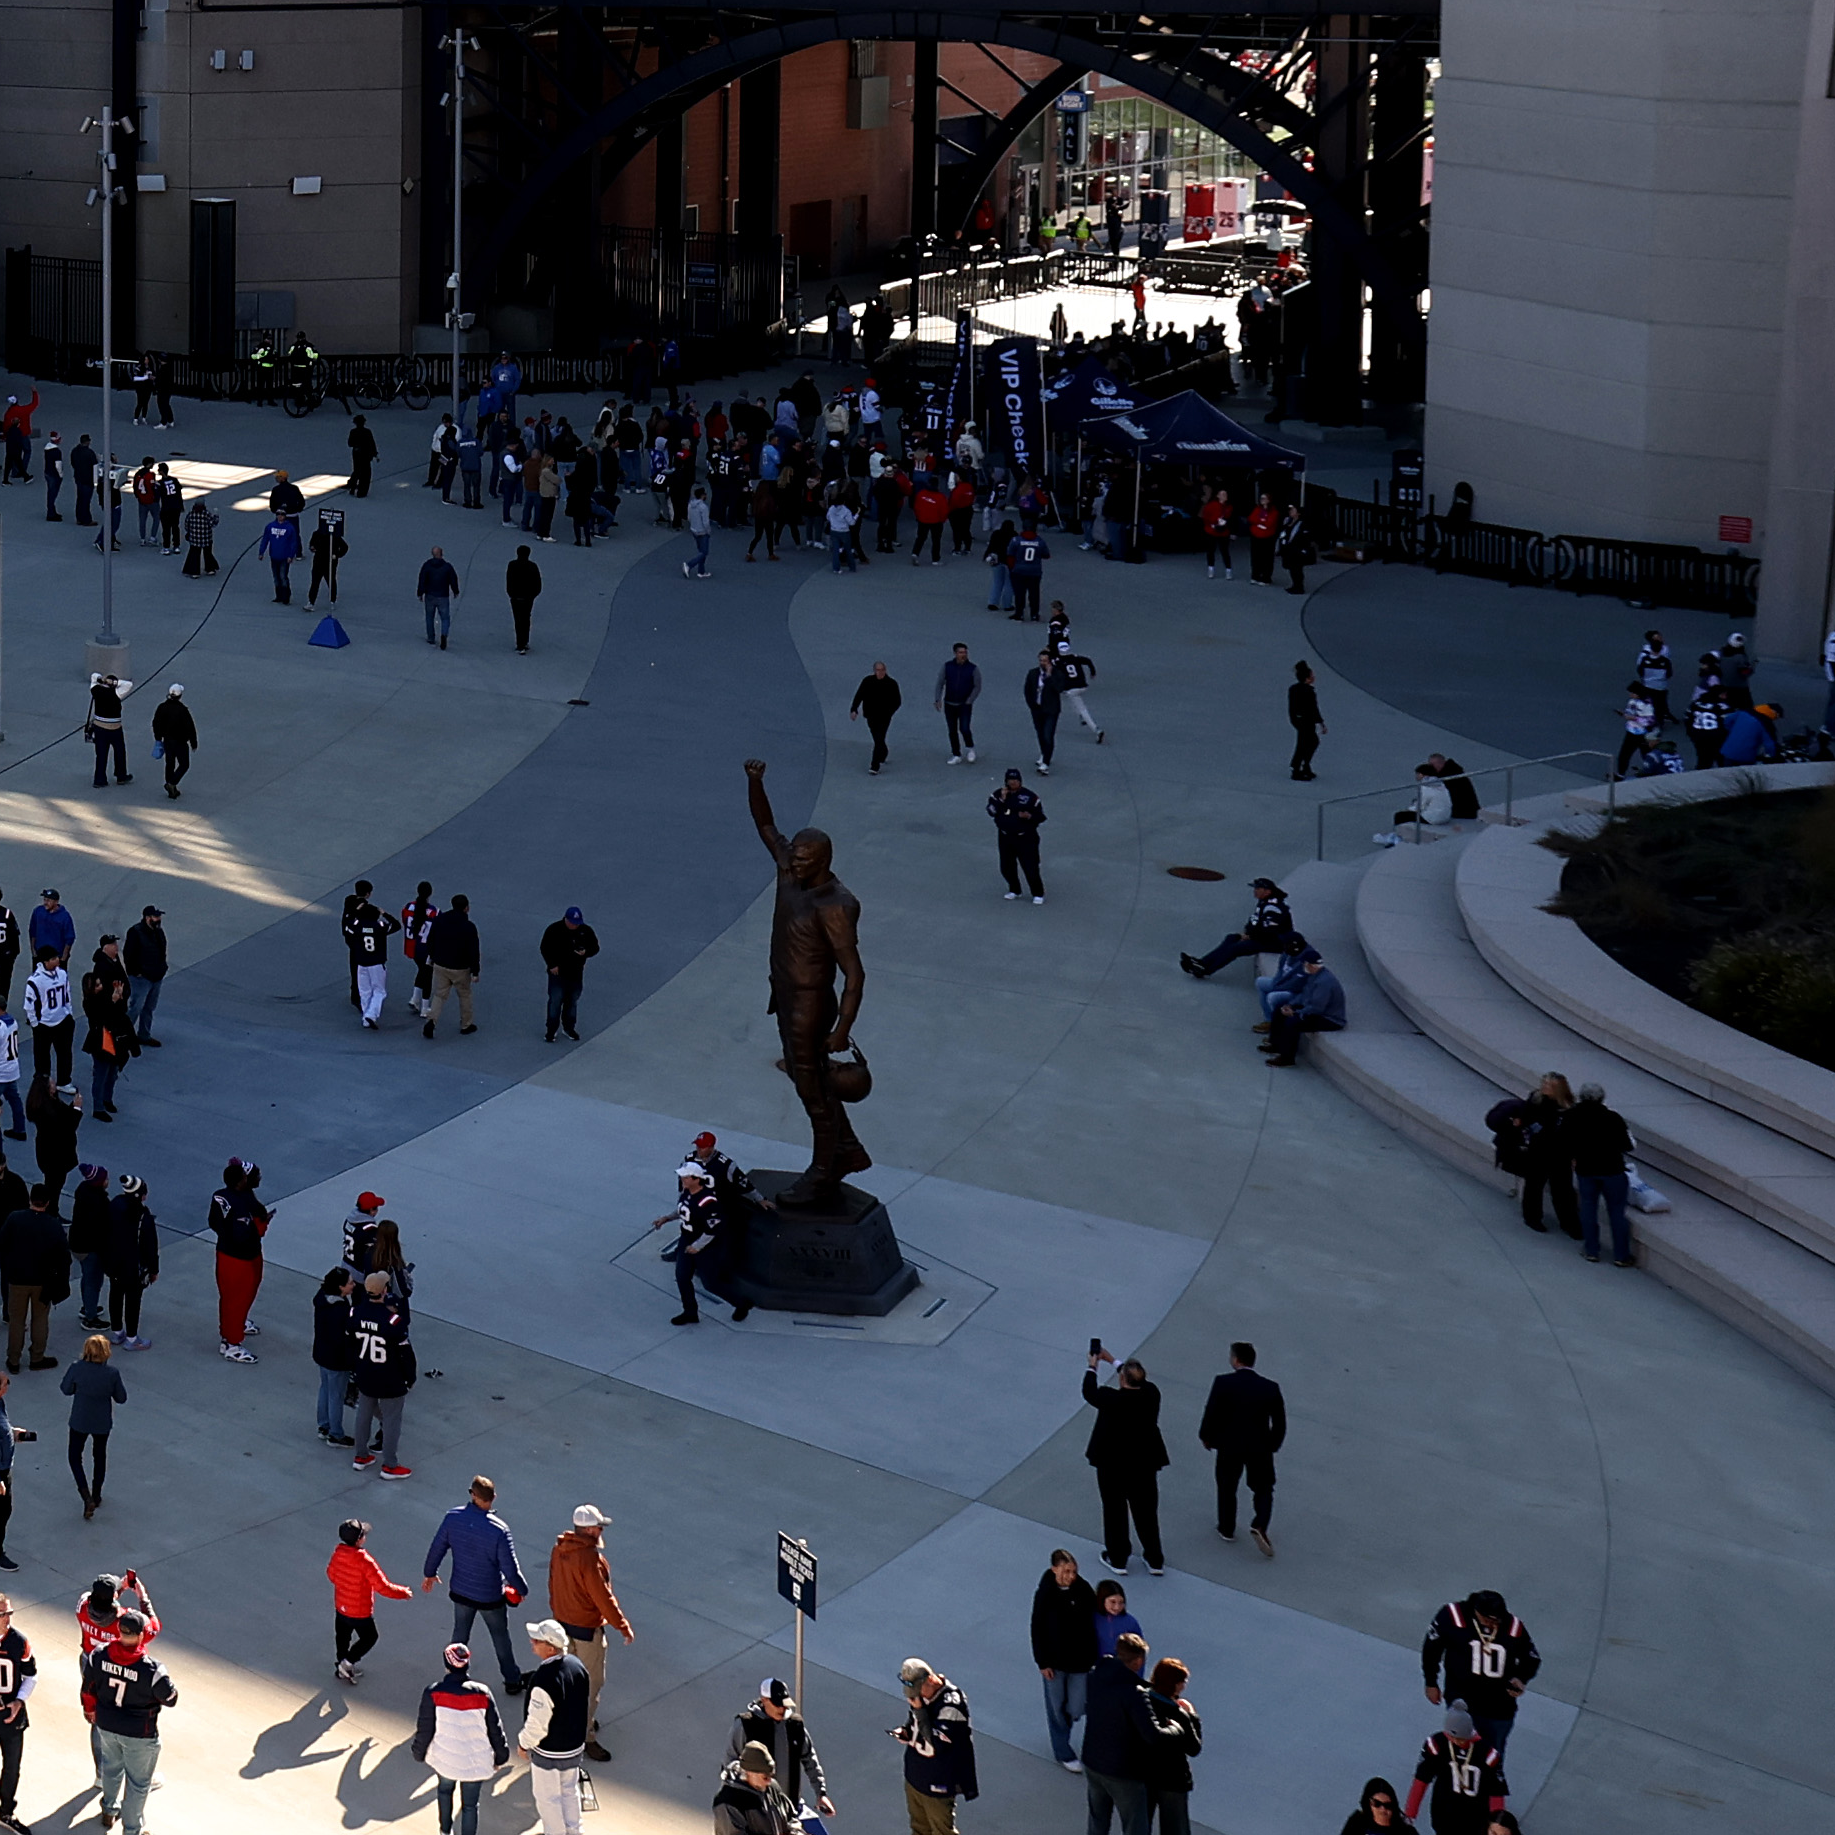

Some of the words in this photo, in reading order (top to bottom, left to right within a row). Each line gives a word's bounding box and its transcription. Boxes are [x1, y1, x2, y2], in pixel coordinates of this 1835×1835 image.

[1065, 115, 1074, 161] HALL
[998, 348, 1021, 390] VIP
[1003, 394, 1029, 473] Check-
[166, 484, 176, 495] 12
[364, 935, 375, 952] 8
[47, 986, 66, 1009] 87
[360, 1320, 378, 1331] WYNN
[356, 1332, 387, 1363] 76
[781, 1540, 799, 1559] PLEASE
[799, 1551, 813, 1569] HAVE
[101, 1661, 123, 1676] MIKEY
[124, 1669, 138, 1682] MOO
[1469, 1639, 1507, 1679] 10
[108, 1679, 127, 1707] 7
[1449, 1761, 1481, 1797] 10
